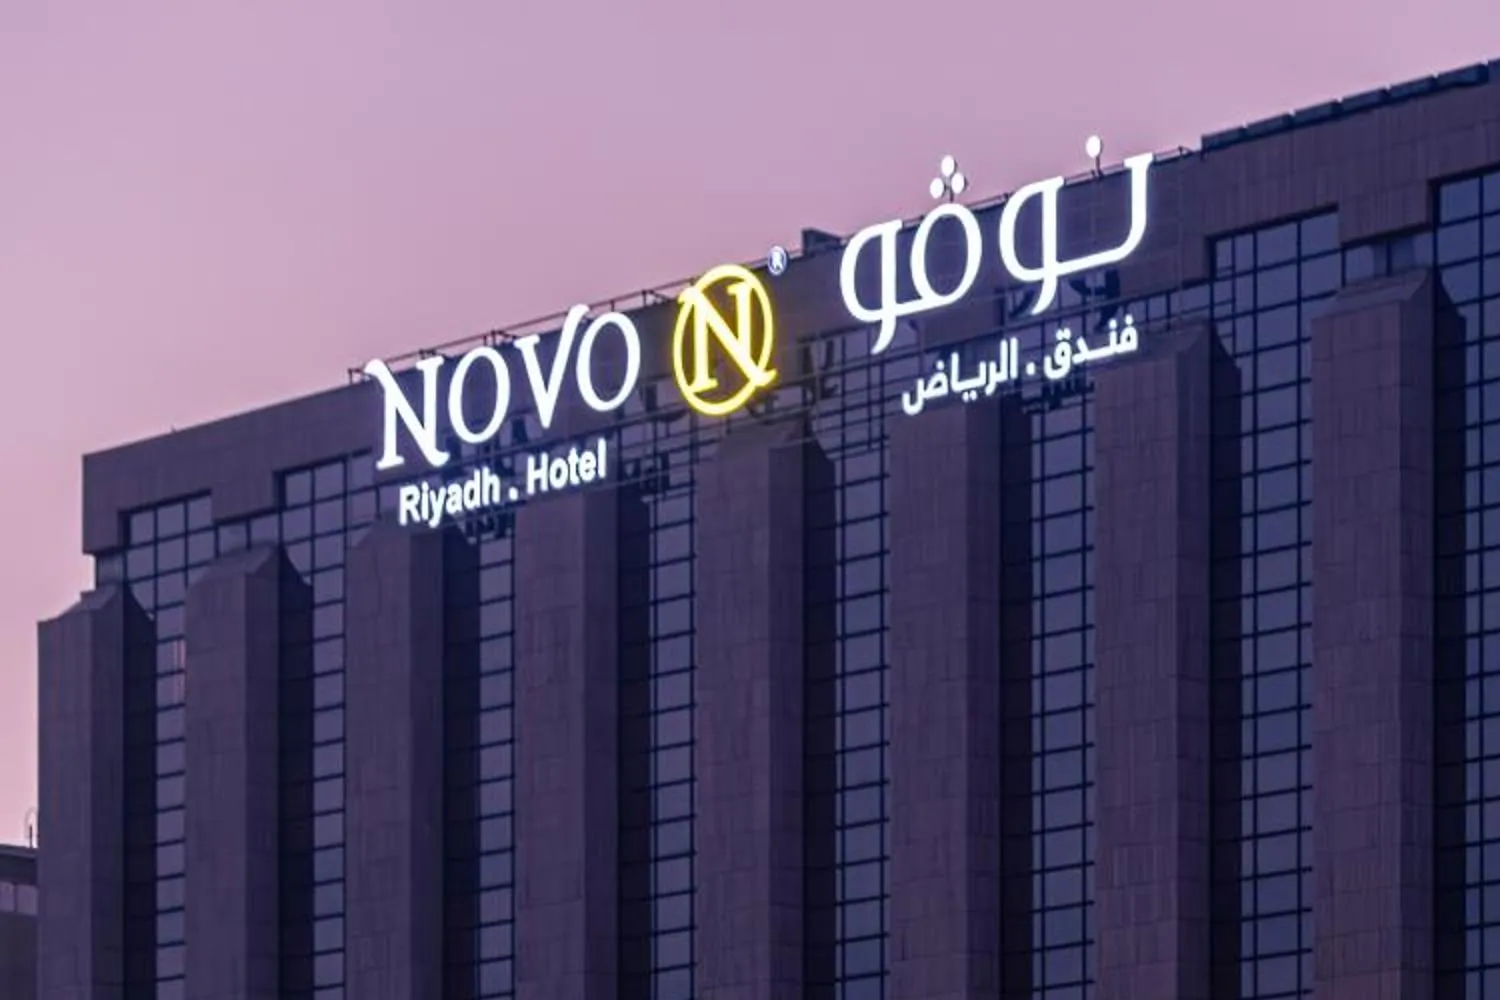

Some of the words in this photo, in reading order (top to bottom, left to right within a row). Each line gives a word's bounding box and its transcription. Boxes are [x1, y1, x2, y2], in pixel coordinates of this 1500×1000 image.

[364, 303, 641, 470] NOVO
[902, 337, 1019, 416] الرياض
[1043, 313, 1139, 380] فندق
[399, 466, 500, 528] Riyadh
[526, 437, 607, 496] Hotel
